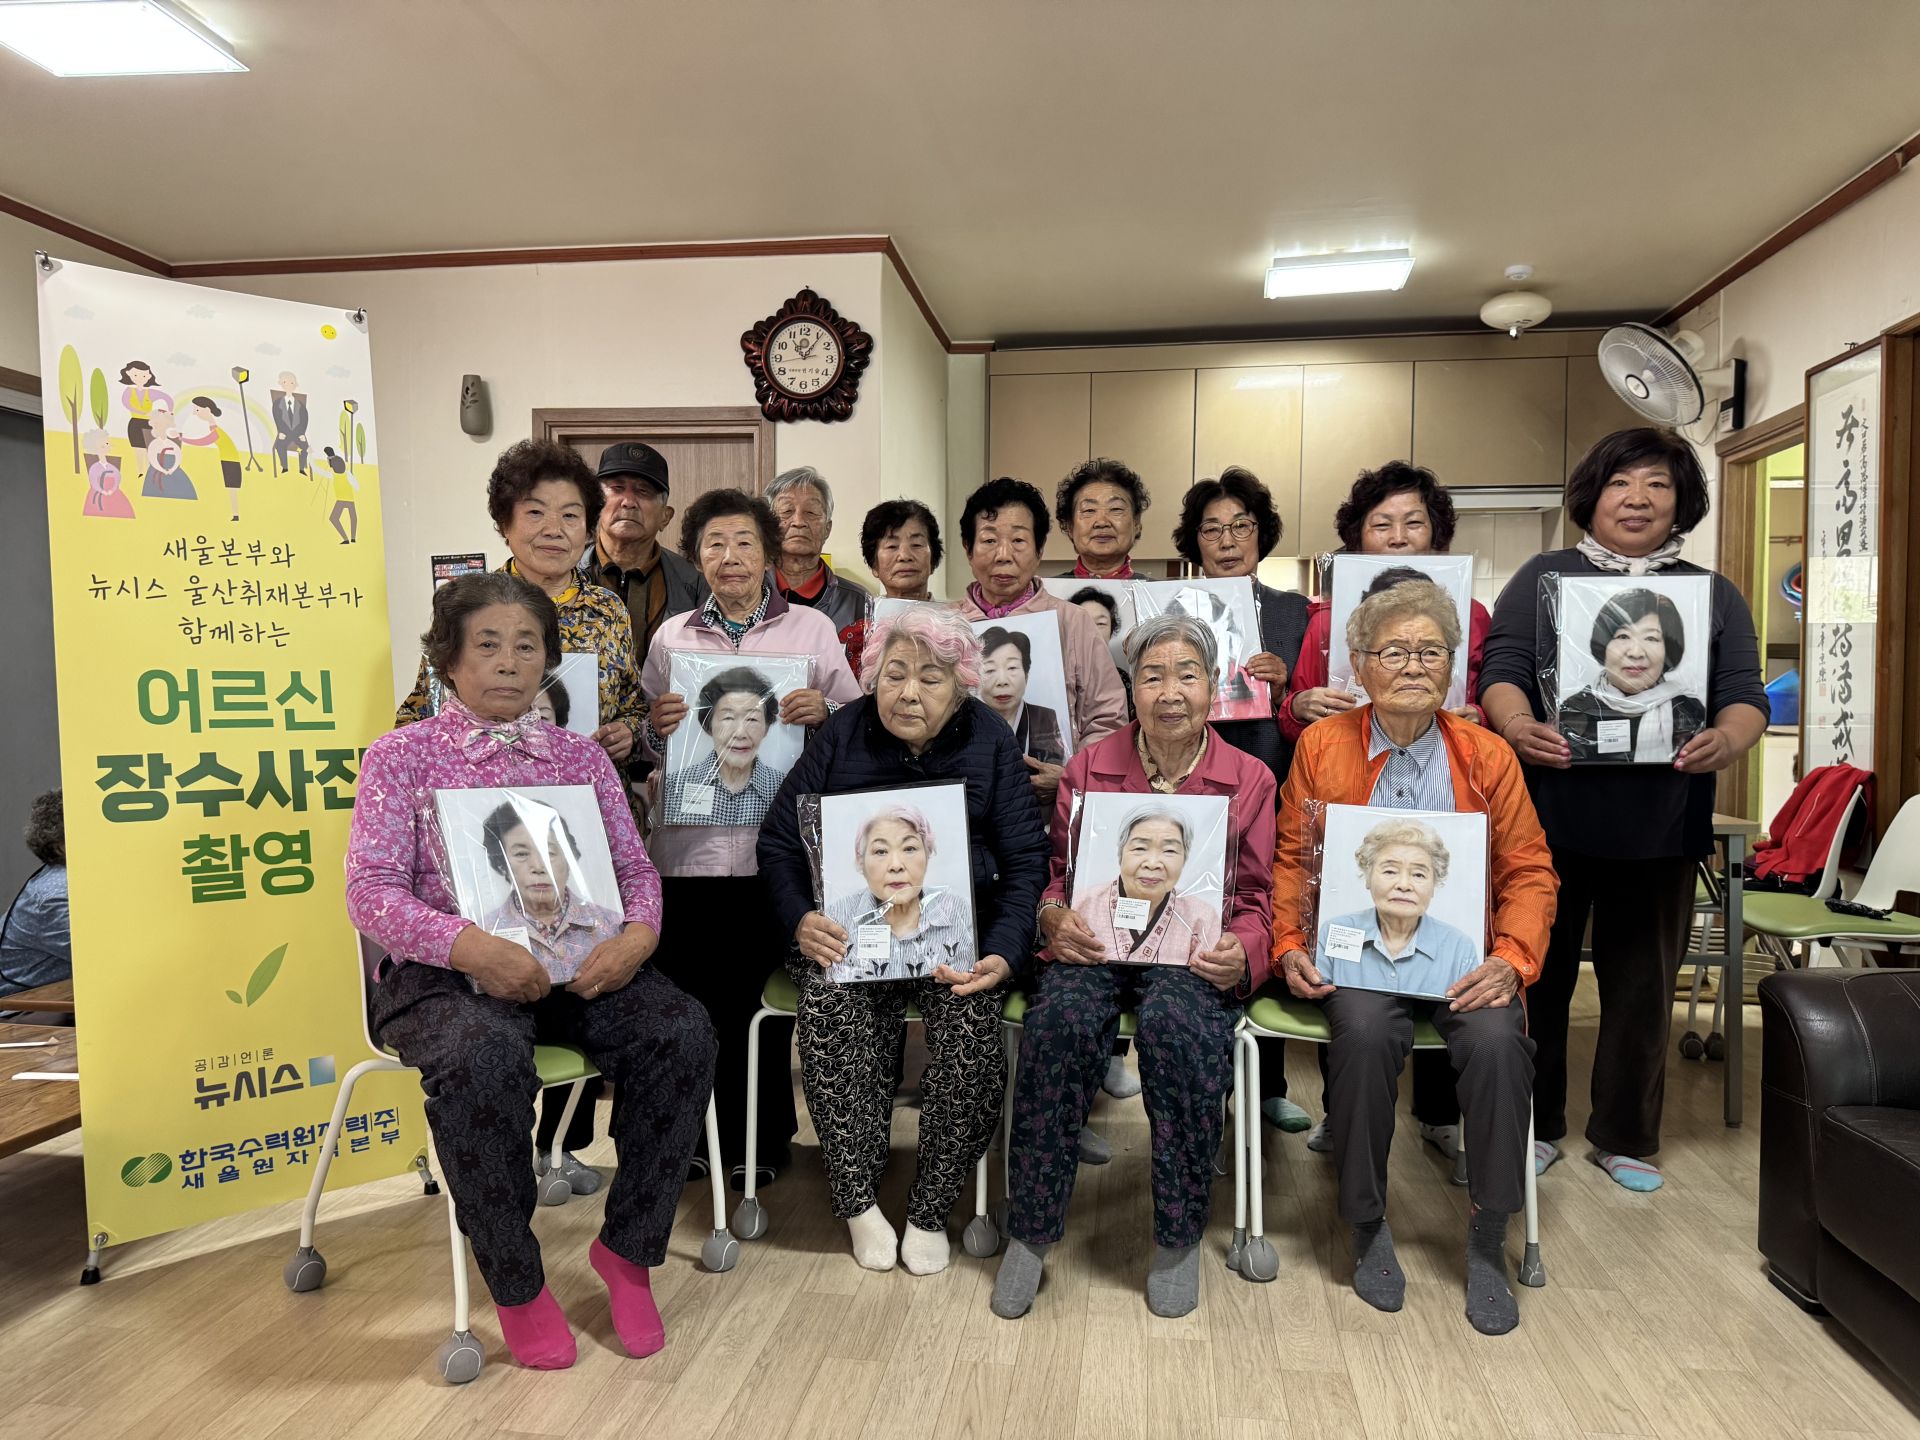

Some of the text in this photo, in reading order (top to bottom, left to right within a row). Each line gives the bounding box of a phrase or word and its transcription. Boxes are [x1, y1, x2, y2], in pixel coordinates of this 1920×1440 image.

[800, 327, 811, 337] 12
[778, 341, 788, 351] 10
[823, 341, 831, 351] 2
[774, 353, 783, 363] 9
[825, 355, 834, 364] 3
[777, 367, 787, 376] 8
[821, 368, 829, 377] 4
[788, 377, 796, 386] 7
[800, 381, 808, 390] 6
[812, 378, 820, 387] 5
[163, 535, 296, 568] 새울본부와
[88, 574, 364, 609] 뉴시스 울산취재본부가
[178, 616, 291, 648] 함께하는
[137, 668, 336, 734] 어르신
[181, 829, 315, 904] 촬영
[194, 1064, 305, 1110] 뉴시스
